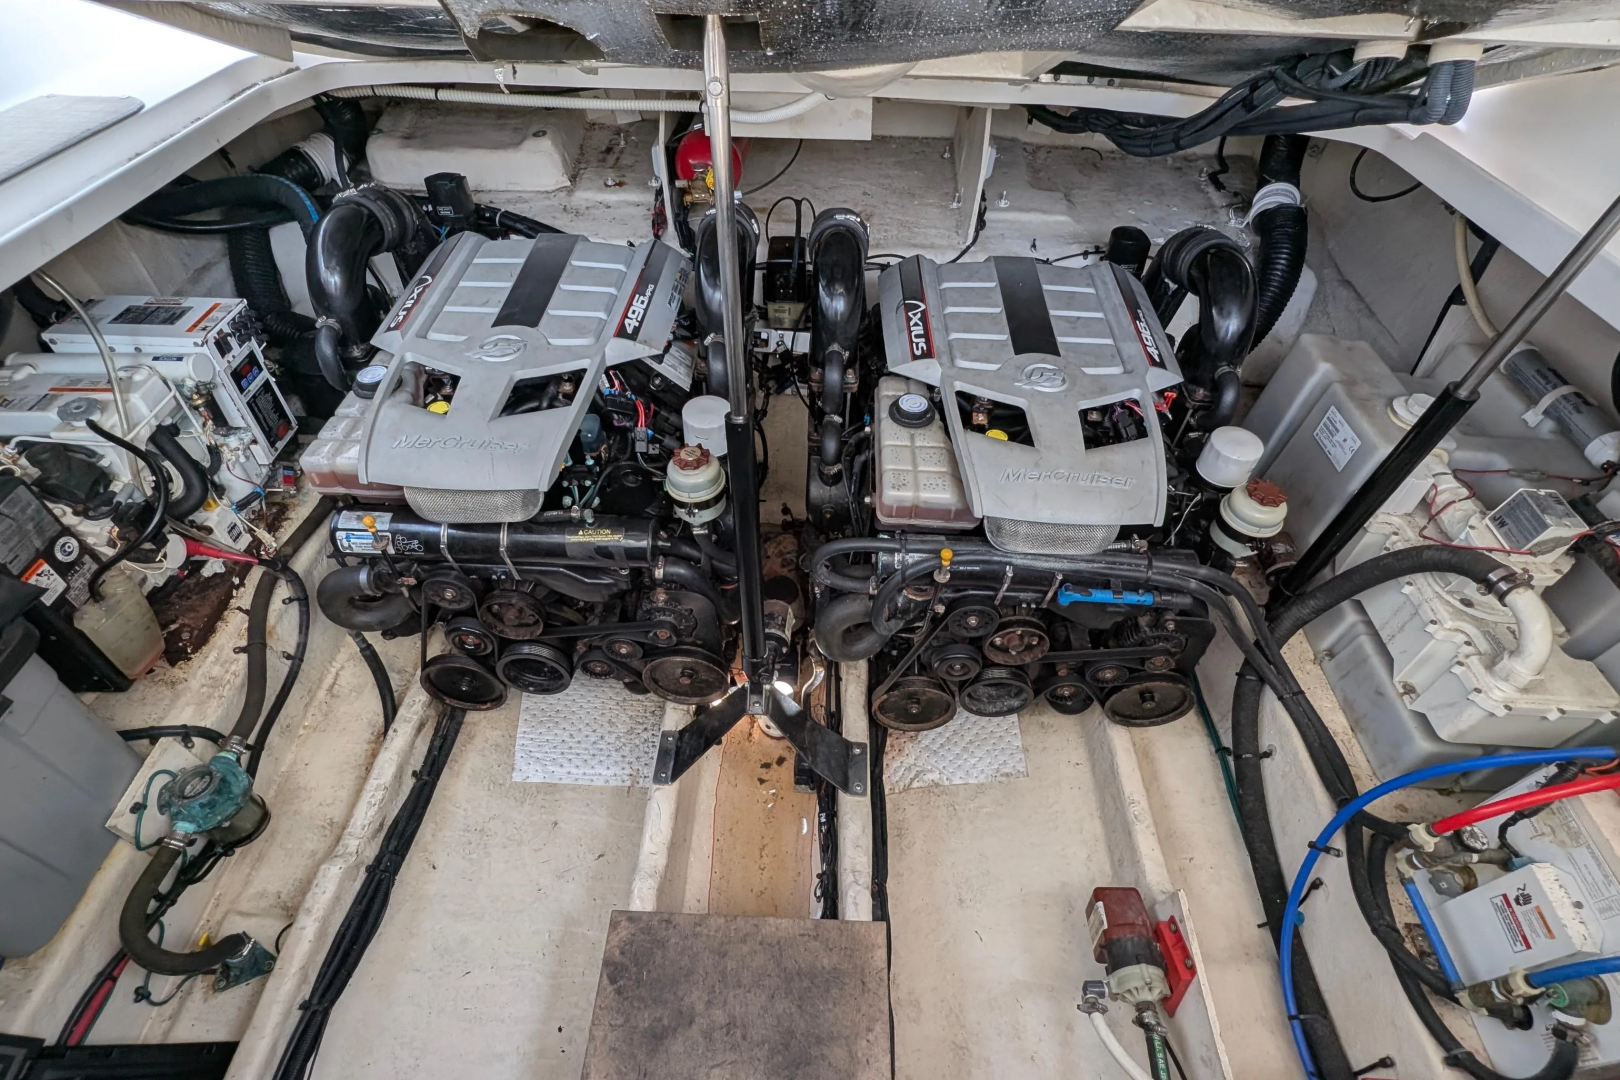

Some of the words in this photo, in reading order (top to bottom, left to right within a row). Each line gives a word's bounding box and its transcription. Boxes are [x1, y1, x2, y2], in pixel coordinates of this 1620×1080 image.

[390, 275, 432, 328] AXIUS
[624, 294, 649, 334] 496
[905, 300, 927, 356] AXIUS
[1136, 320, 1160, 363] 496
[391, 435, 531, 454] MerCruiser
[999, 469, 1137, 490] MerCruiser
[1492, 512, 1508, 530] JW
[1157, 1053, 1165, 1068] SAE
